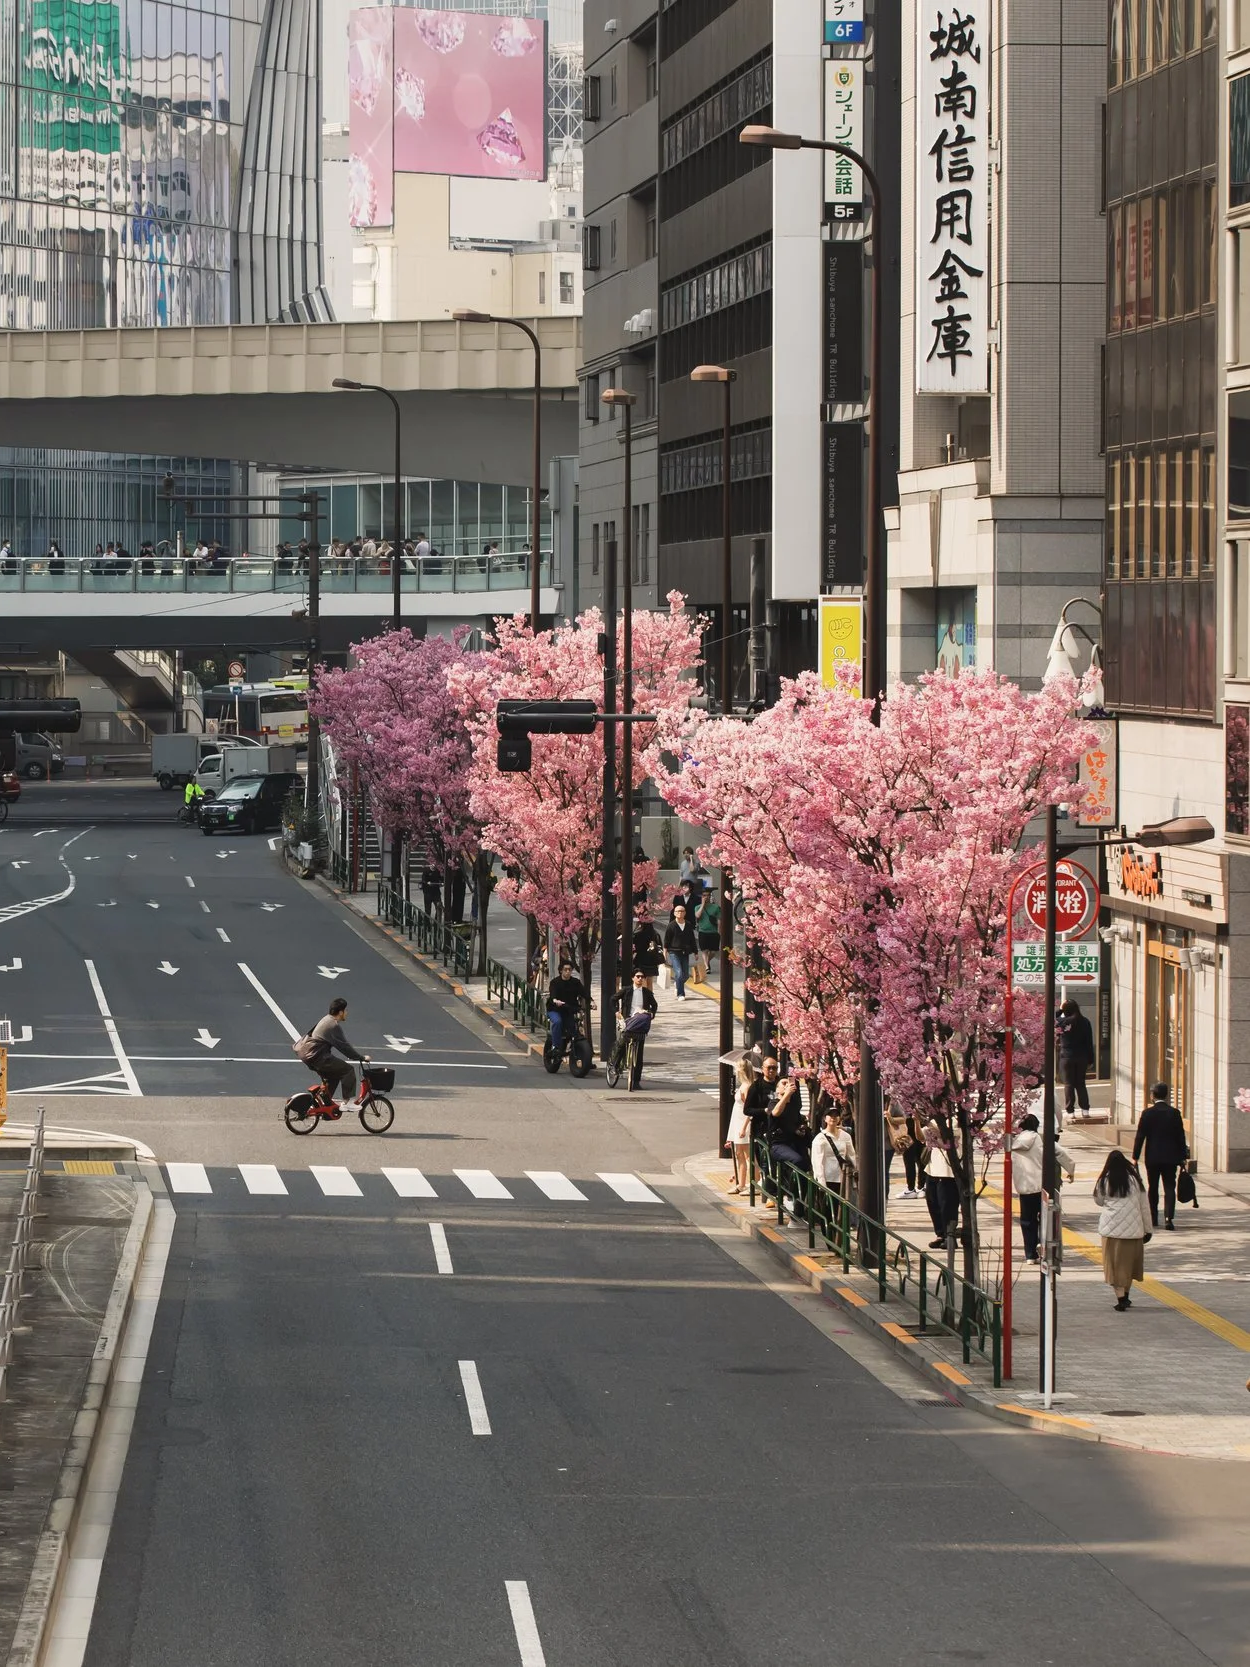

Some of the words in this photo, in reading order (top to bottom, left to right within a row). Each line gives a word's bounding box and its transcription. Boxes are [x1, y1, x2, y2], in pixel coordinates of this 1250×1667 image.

[835, 24, 853, 37] 6F
[926, 7, 984, 377] 城南信用金庫
[834, 205, 854, 218] 5F
[829, 256, 838, 292] Shibuya
[829, 297, 837, 338] sanchome
[829, 343, 838, 354] TR
[827, 358, 838, 399] Building
[828, 437, 838, 473] Shibuya
[828, 477, 837, 518] sanchome
[828, 523, 837, 534] TR
[826, 539, 837, 579] Building
[1016, 958, 1097, 972] 処方ん受付
